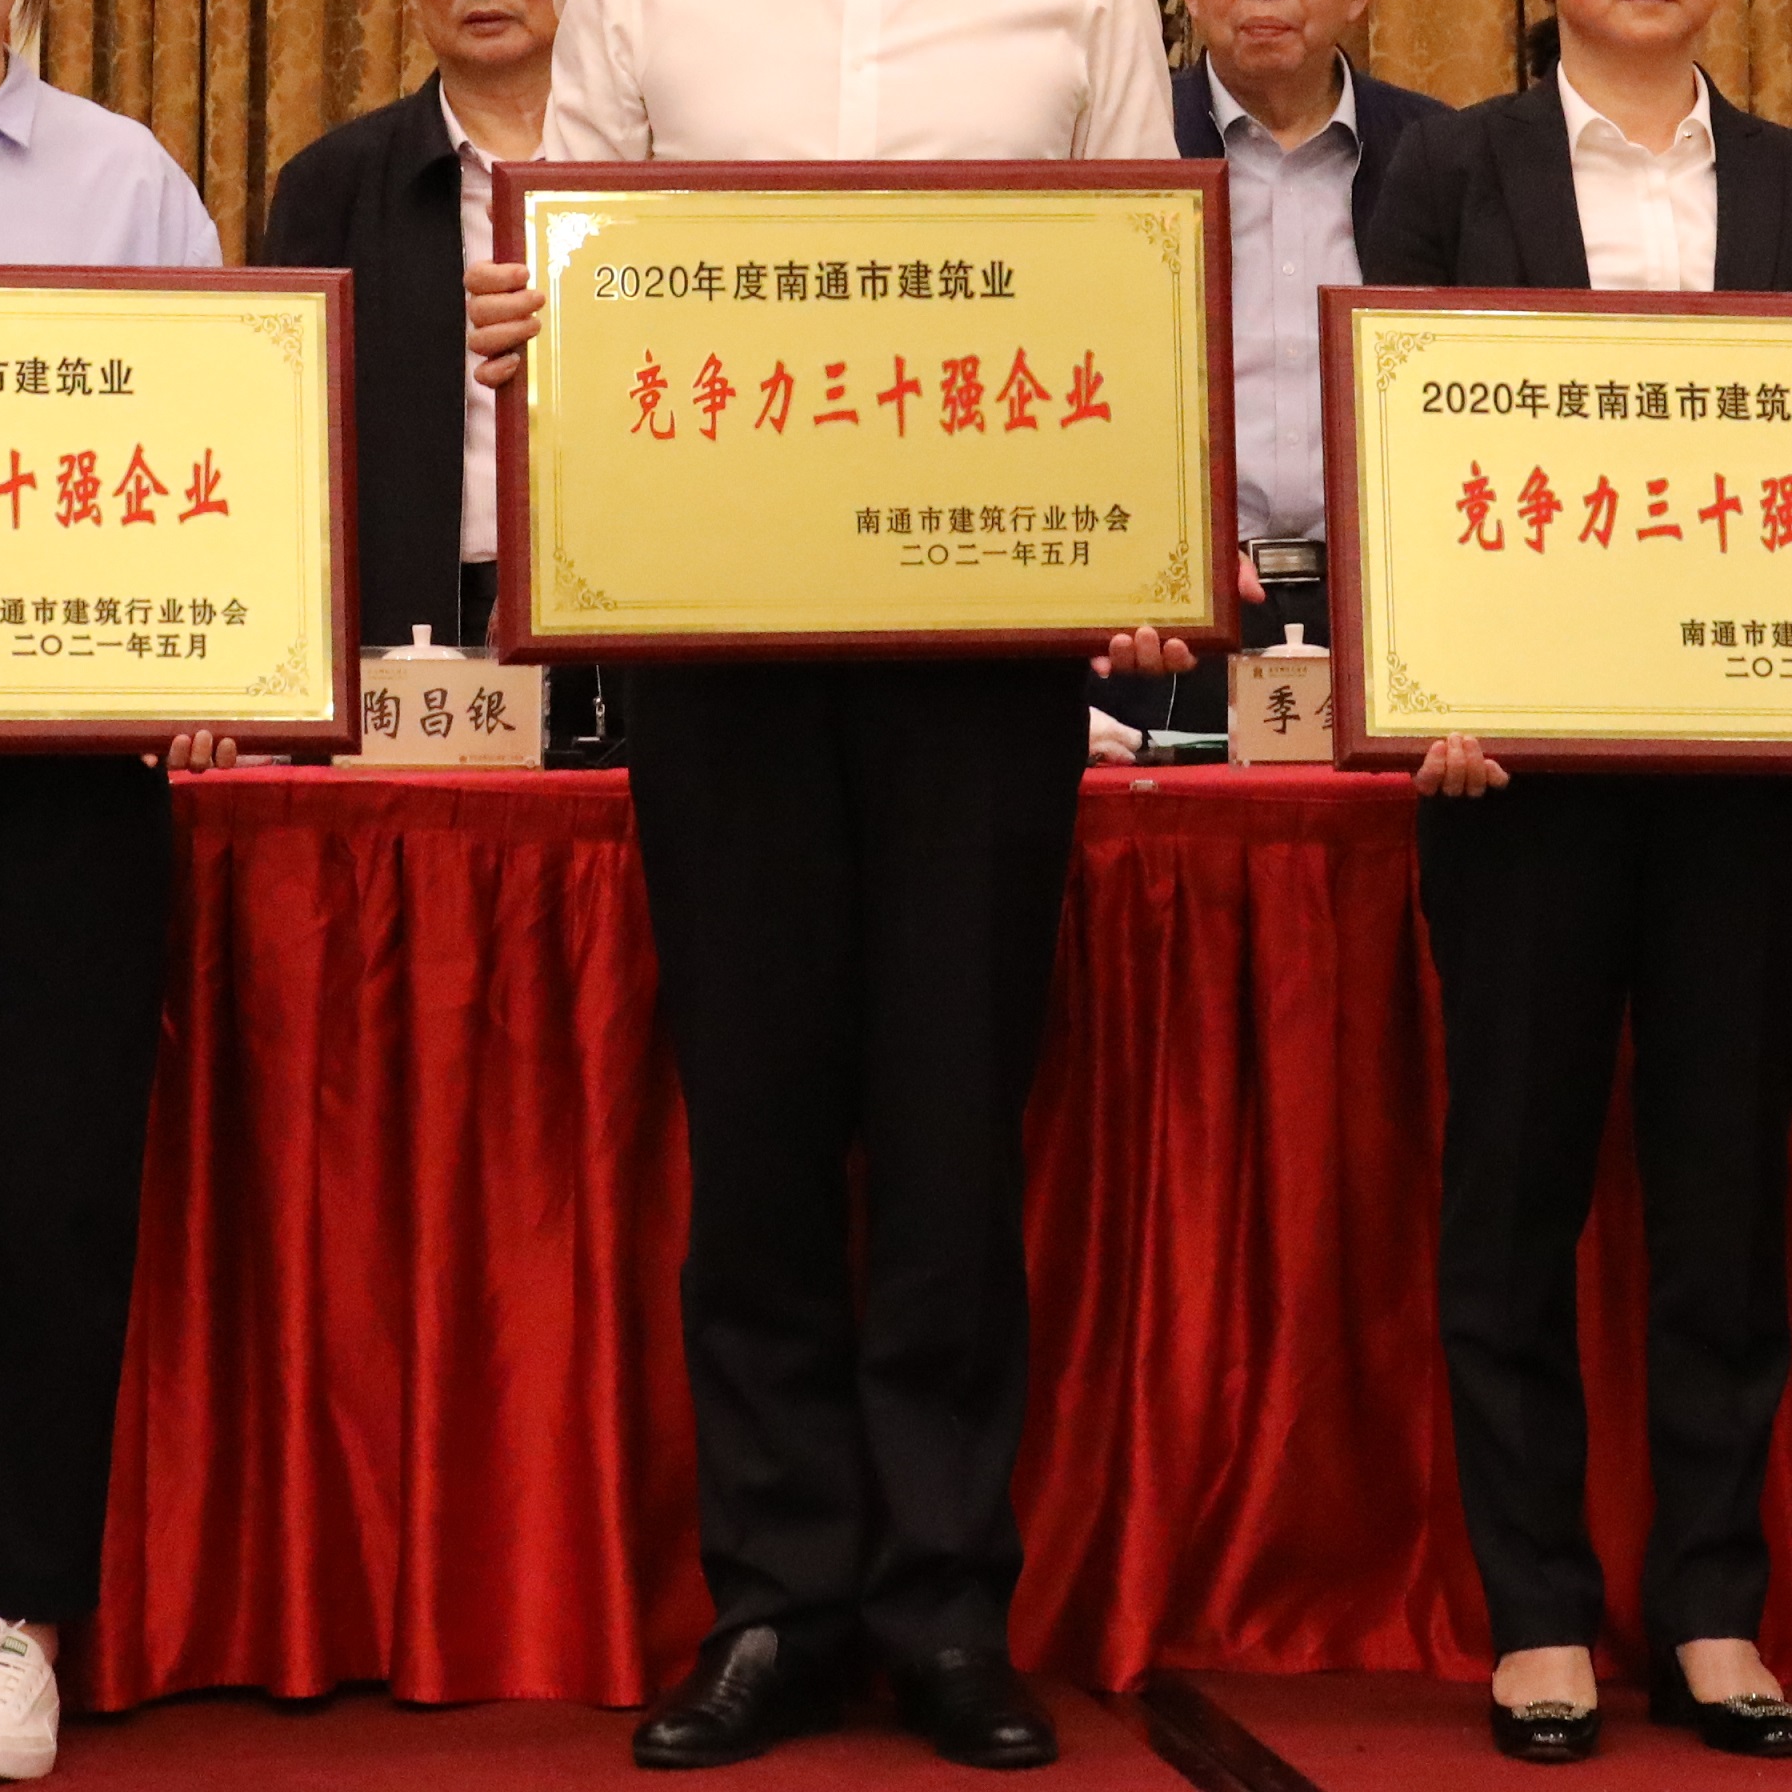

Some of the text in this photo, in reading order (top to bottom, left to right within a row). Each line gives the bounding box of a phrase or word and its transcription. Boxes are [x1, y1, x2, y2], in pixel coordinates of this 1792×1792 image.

[597, 260, 1015, 301] 2020年度南通市建筑业
[630, 348, 1110, 441] 竞争力三十强企业
[856, 504, 1130, 534] 南通市建筑行业协会
[364, 687, 516, 739] 陶昌银
